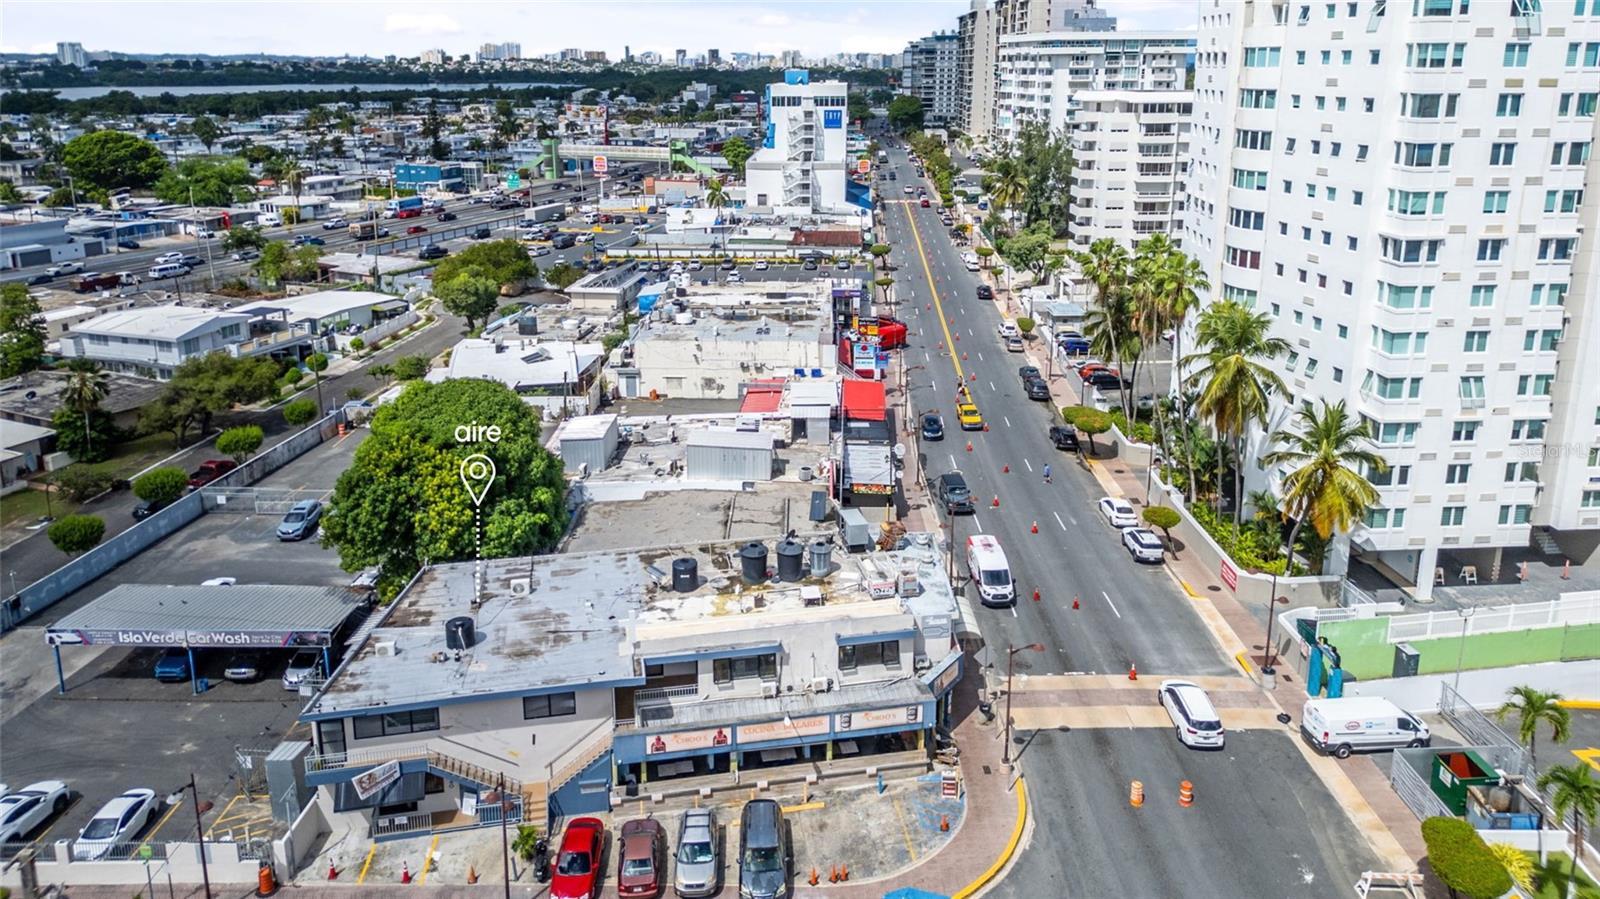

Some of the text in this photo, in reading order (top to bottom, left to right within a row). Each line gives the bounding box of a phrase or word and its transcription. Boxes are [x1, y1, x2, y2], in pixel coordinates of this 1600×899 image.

[118, 631, 141, 643] Isla
[142, 631, 186, 644] Verde
[187, 632, 210, 644] Car
[210, 632, 250, 644] Wash
